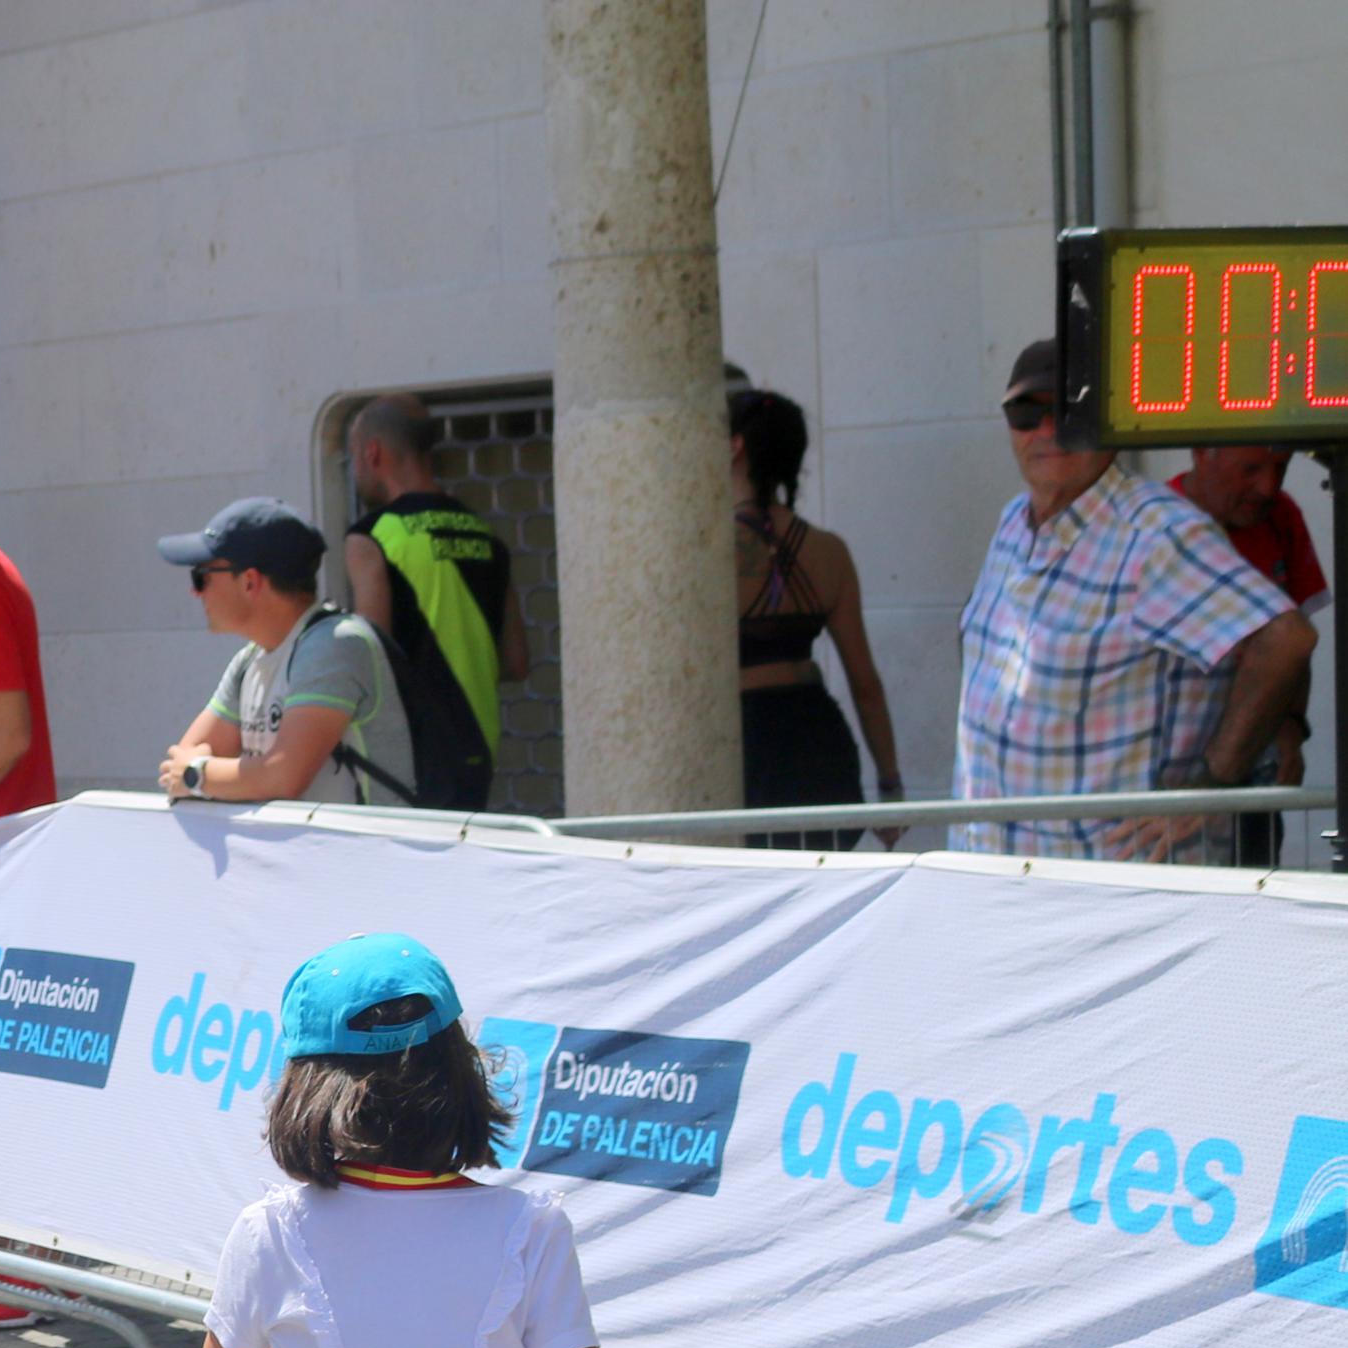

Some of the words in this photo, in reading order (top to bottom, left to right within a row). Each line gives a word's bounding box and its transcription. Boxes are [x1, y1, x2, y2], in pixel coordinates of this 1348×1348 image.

[14, 1022, 109, 1066] PALENCIA
[554, 1050, 699, 1105] Diputación
[538, 1109, 577, 1150] DE
[579, 1115, 719, 1168] PALENCIA
[782, 1053, 1244, 1247] deportes
